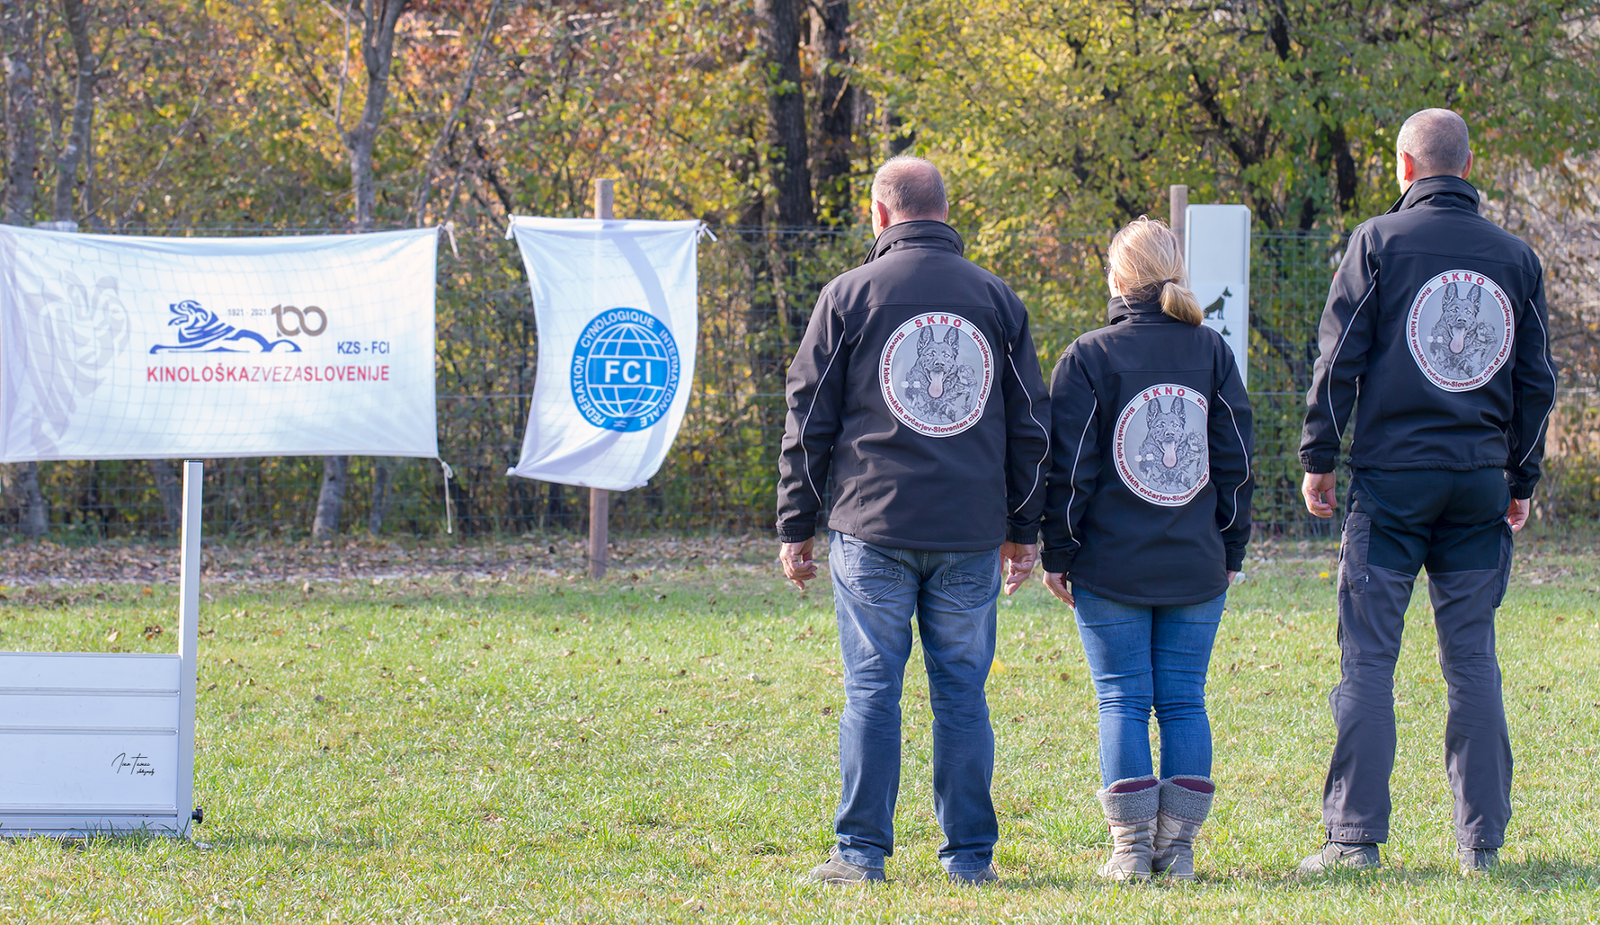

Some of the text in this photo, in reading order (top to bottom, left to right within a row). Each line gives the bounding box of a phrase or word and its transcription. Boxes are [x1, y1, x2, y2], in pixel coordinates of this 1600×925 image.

[1441, 273, 1485, 286] SKNO
[1412, 286, 1432, 319] Slovenski
[1493, 289, 1511, 327] Shepherds
[271, 303, 328, 338] 100
[914, 315, 962, 328] SKNO
[337, 341, 361, 354] KZS
[371, 341, 390, 354] FCI
[883, 331, 905, 366] Slovenski
[971, 331, 990, 368] Shepherds
[1499, 328, 1511, 357] German
[573, 310, 679, 428] FEDERATION CYNOLOGIQUE INTERNATIONALE
[605, 360, 652, 383] FCI
[1483, 365, 1494, 378] club
[1493, 357, 1501, 366] of
[979, 369, 990, 400] German
[1142, 387, 1186, 402] SKNO
[968, 408, 981, 422] club
[1117, 406, 1136, 441] Slovenski
